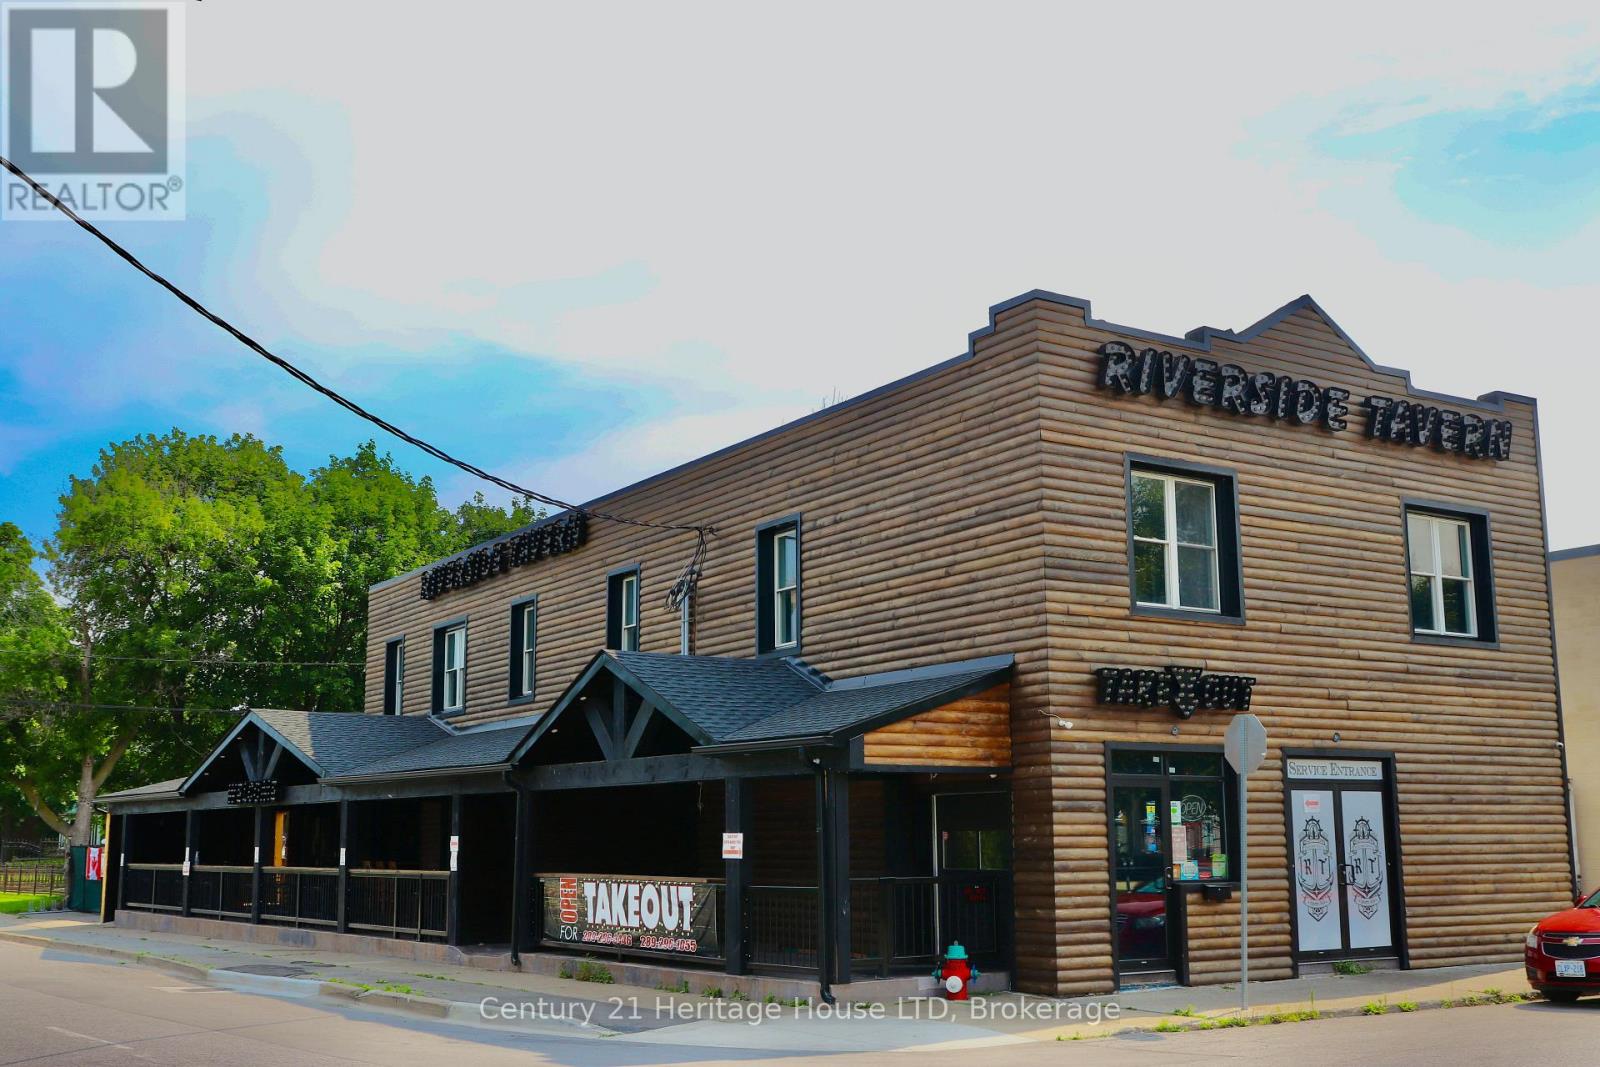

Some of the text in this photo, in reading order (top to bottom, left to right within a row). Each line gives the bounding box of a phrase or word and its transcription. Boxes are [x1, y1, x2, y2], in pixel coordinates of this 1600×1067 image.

[1098, 341, 1513, 462] RIVERSIDE TAVERN
[1288, 761, 1378, 777] SERVICE ENTRANCE
[560, 877, 578, 923] OPEN
[583, 882, 694, 931] TAKEOUT
[560, 926, 578, 941] FOR
